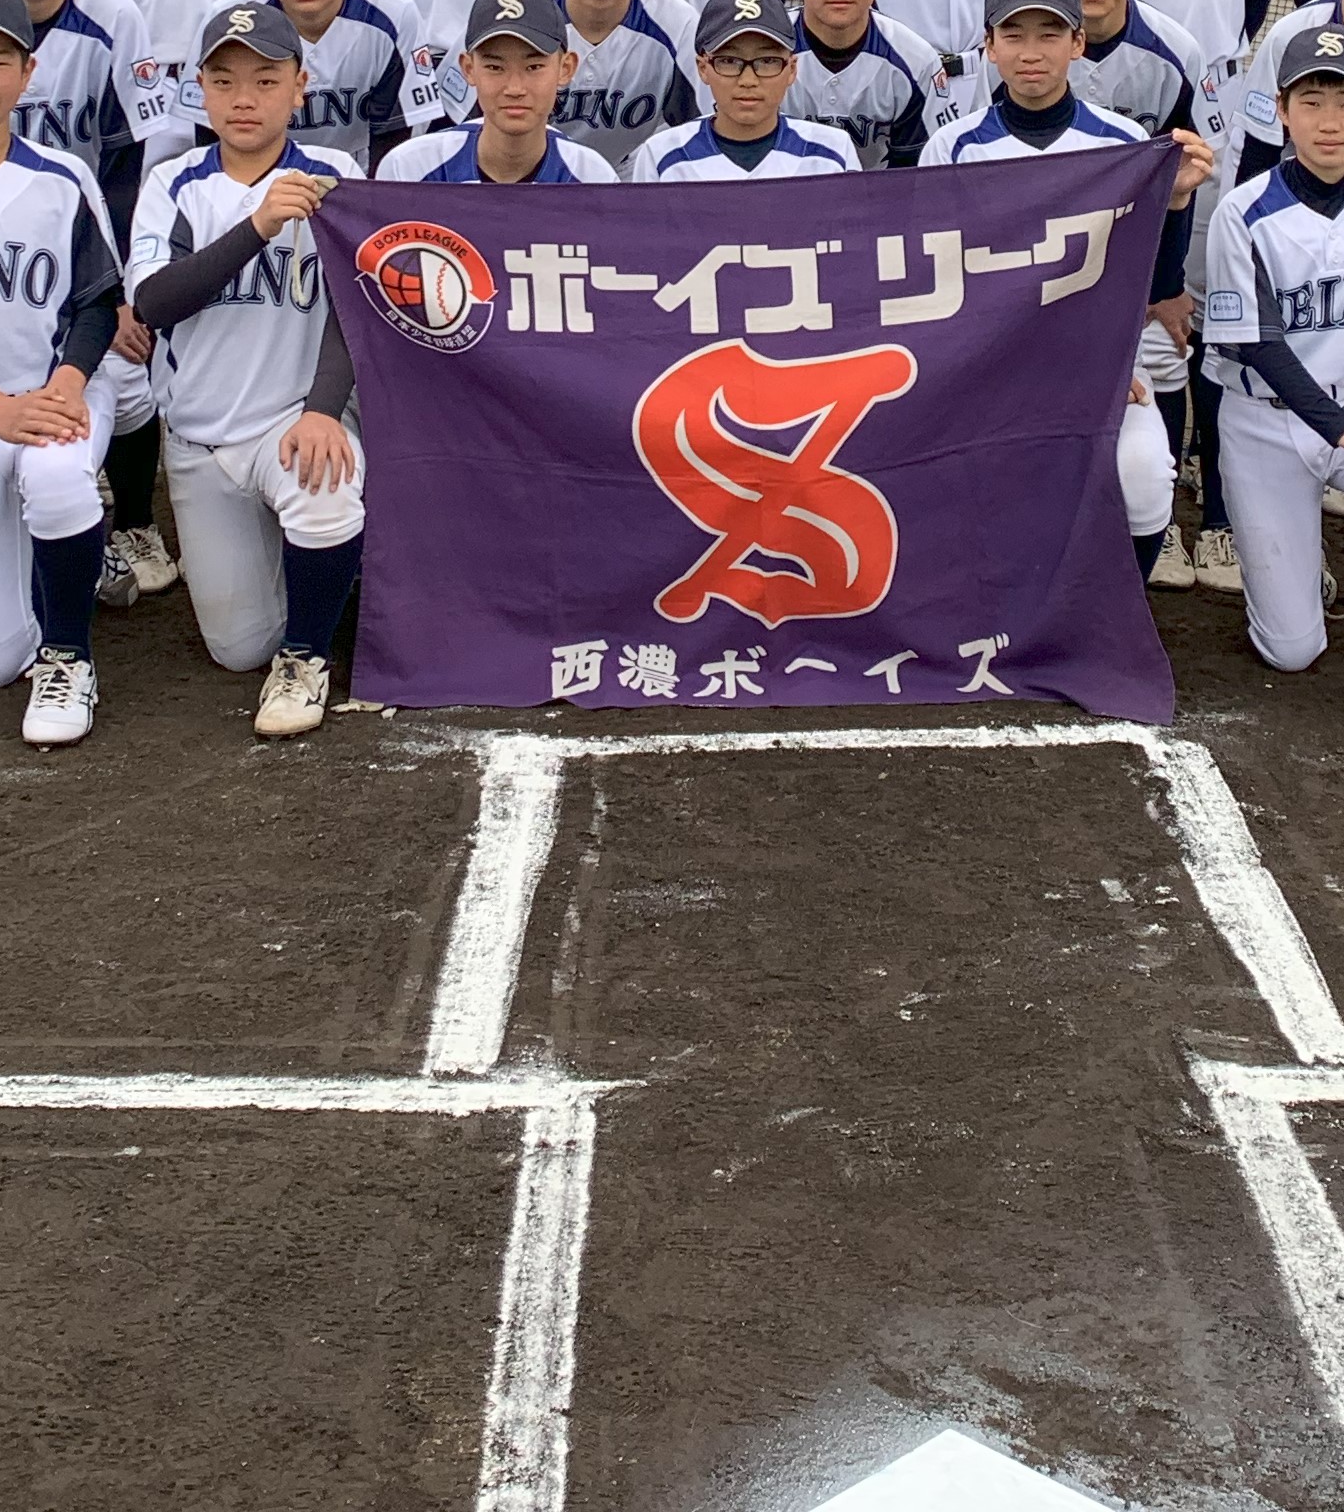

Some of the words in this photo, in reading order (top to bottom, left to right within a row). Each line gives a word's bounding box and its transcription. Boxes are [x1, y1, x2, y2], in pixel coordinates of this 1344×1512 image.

[372, 228, 409, 251] BOYS
[414, 228, 468, 259] LEAGUE
[503, 239, 843, 335] ボーイズ
[876, 202, 1136, 327] リーグ
[550, 633, 1015, 701] 西濃ボーイズ
